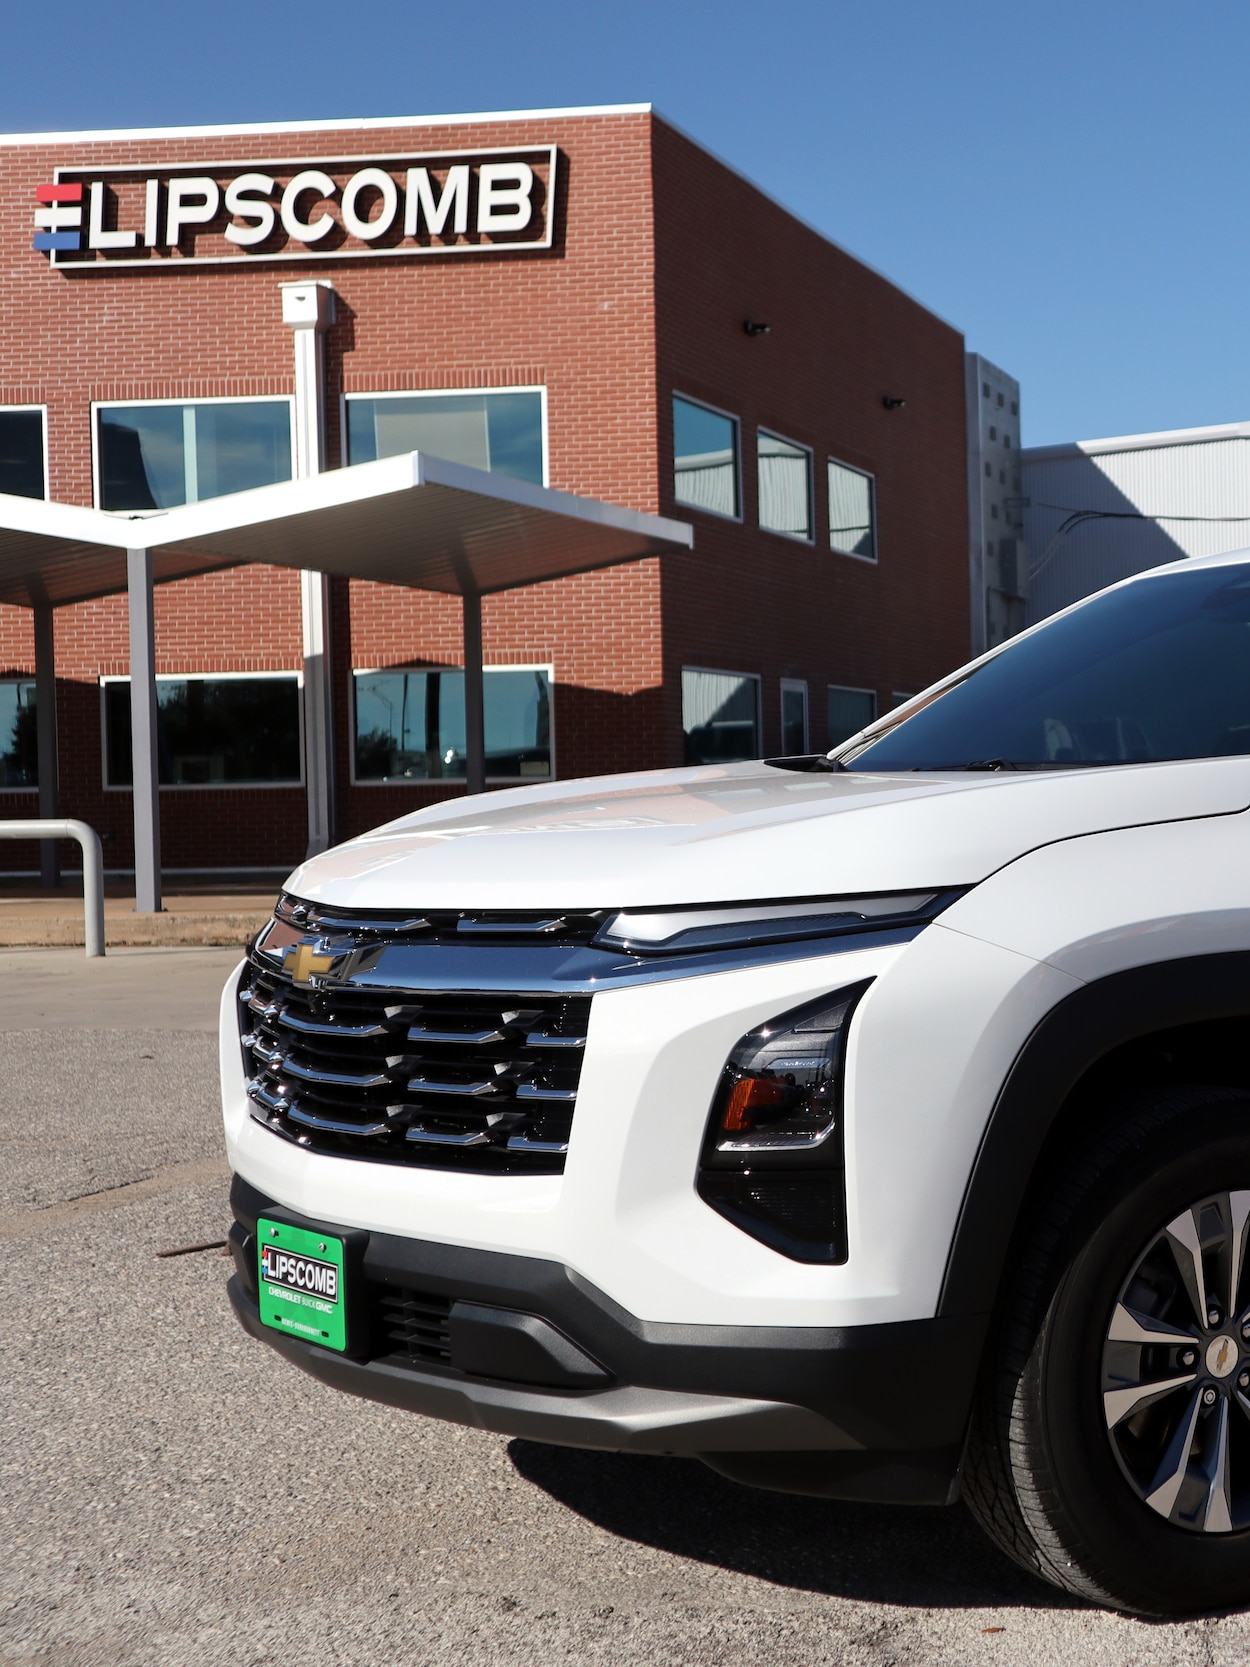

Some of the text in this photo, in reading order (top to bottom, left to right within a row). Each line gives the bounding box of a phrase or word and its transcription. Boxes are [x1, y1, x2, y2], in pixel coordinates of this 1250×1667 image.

[89, 162, 533, 249] LIPSCOMB
[267, 1251, 336, 1296] LIPSCOMB
[268, 1286, 301, 1304] CHEVROLET
[316, 1301, 333, 1315] GMC
